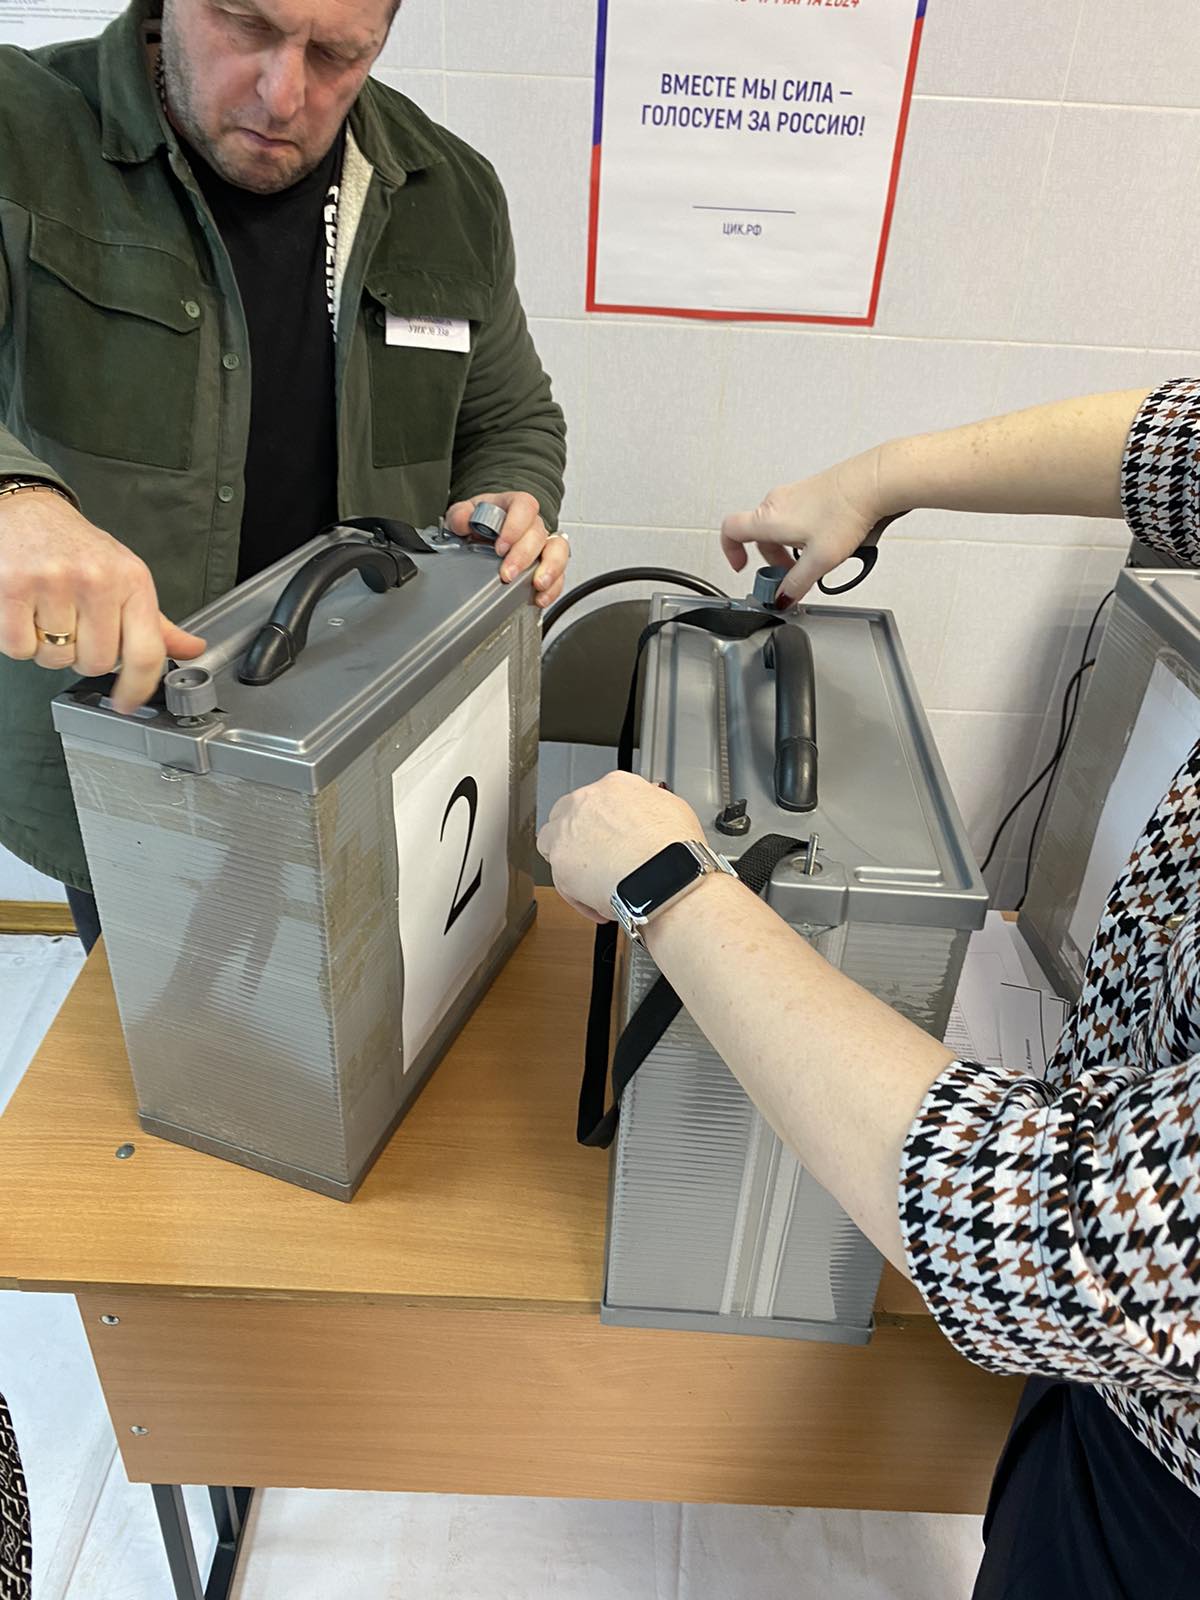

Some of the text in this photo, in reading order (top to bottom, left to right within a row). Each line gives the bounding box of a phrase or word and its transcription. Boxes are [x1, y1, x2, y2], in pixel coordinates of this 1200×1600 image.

[660, 73, 736, 99] ВМЕСТЕ
[742, 78, 776, 101] МЫ
[783, 80, 833, 103] СИЛА
[641, 104, 866, 137] ГОЛОСУЕМ ЗА РОССИЮ!
[722, 222, 762, 236] ЦИК.РФ
[440, 776, 484, 936] 2
